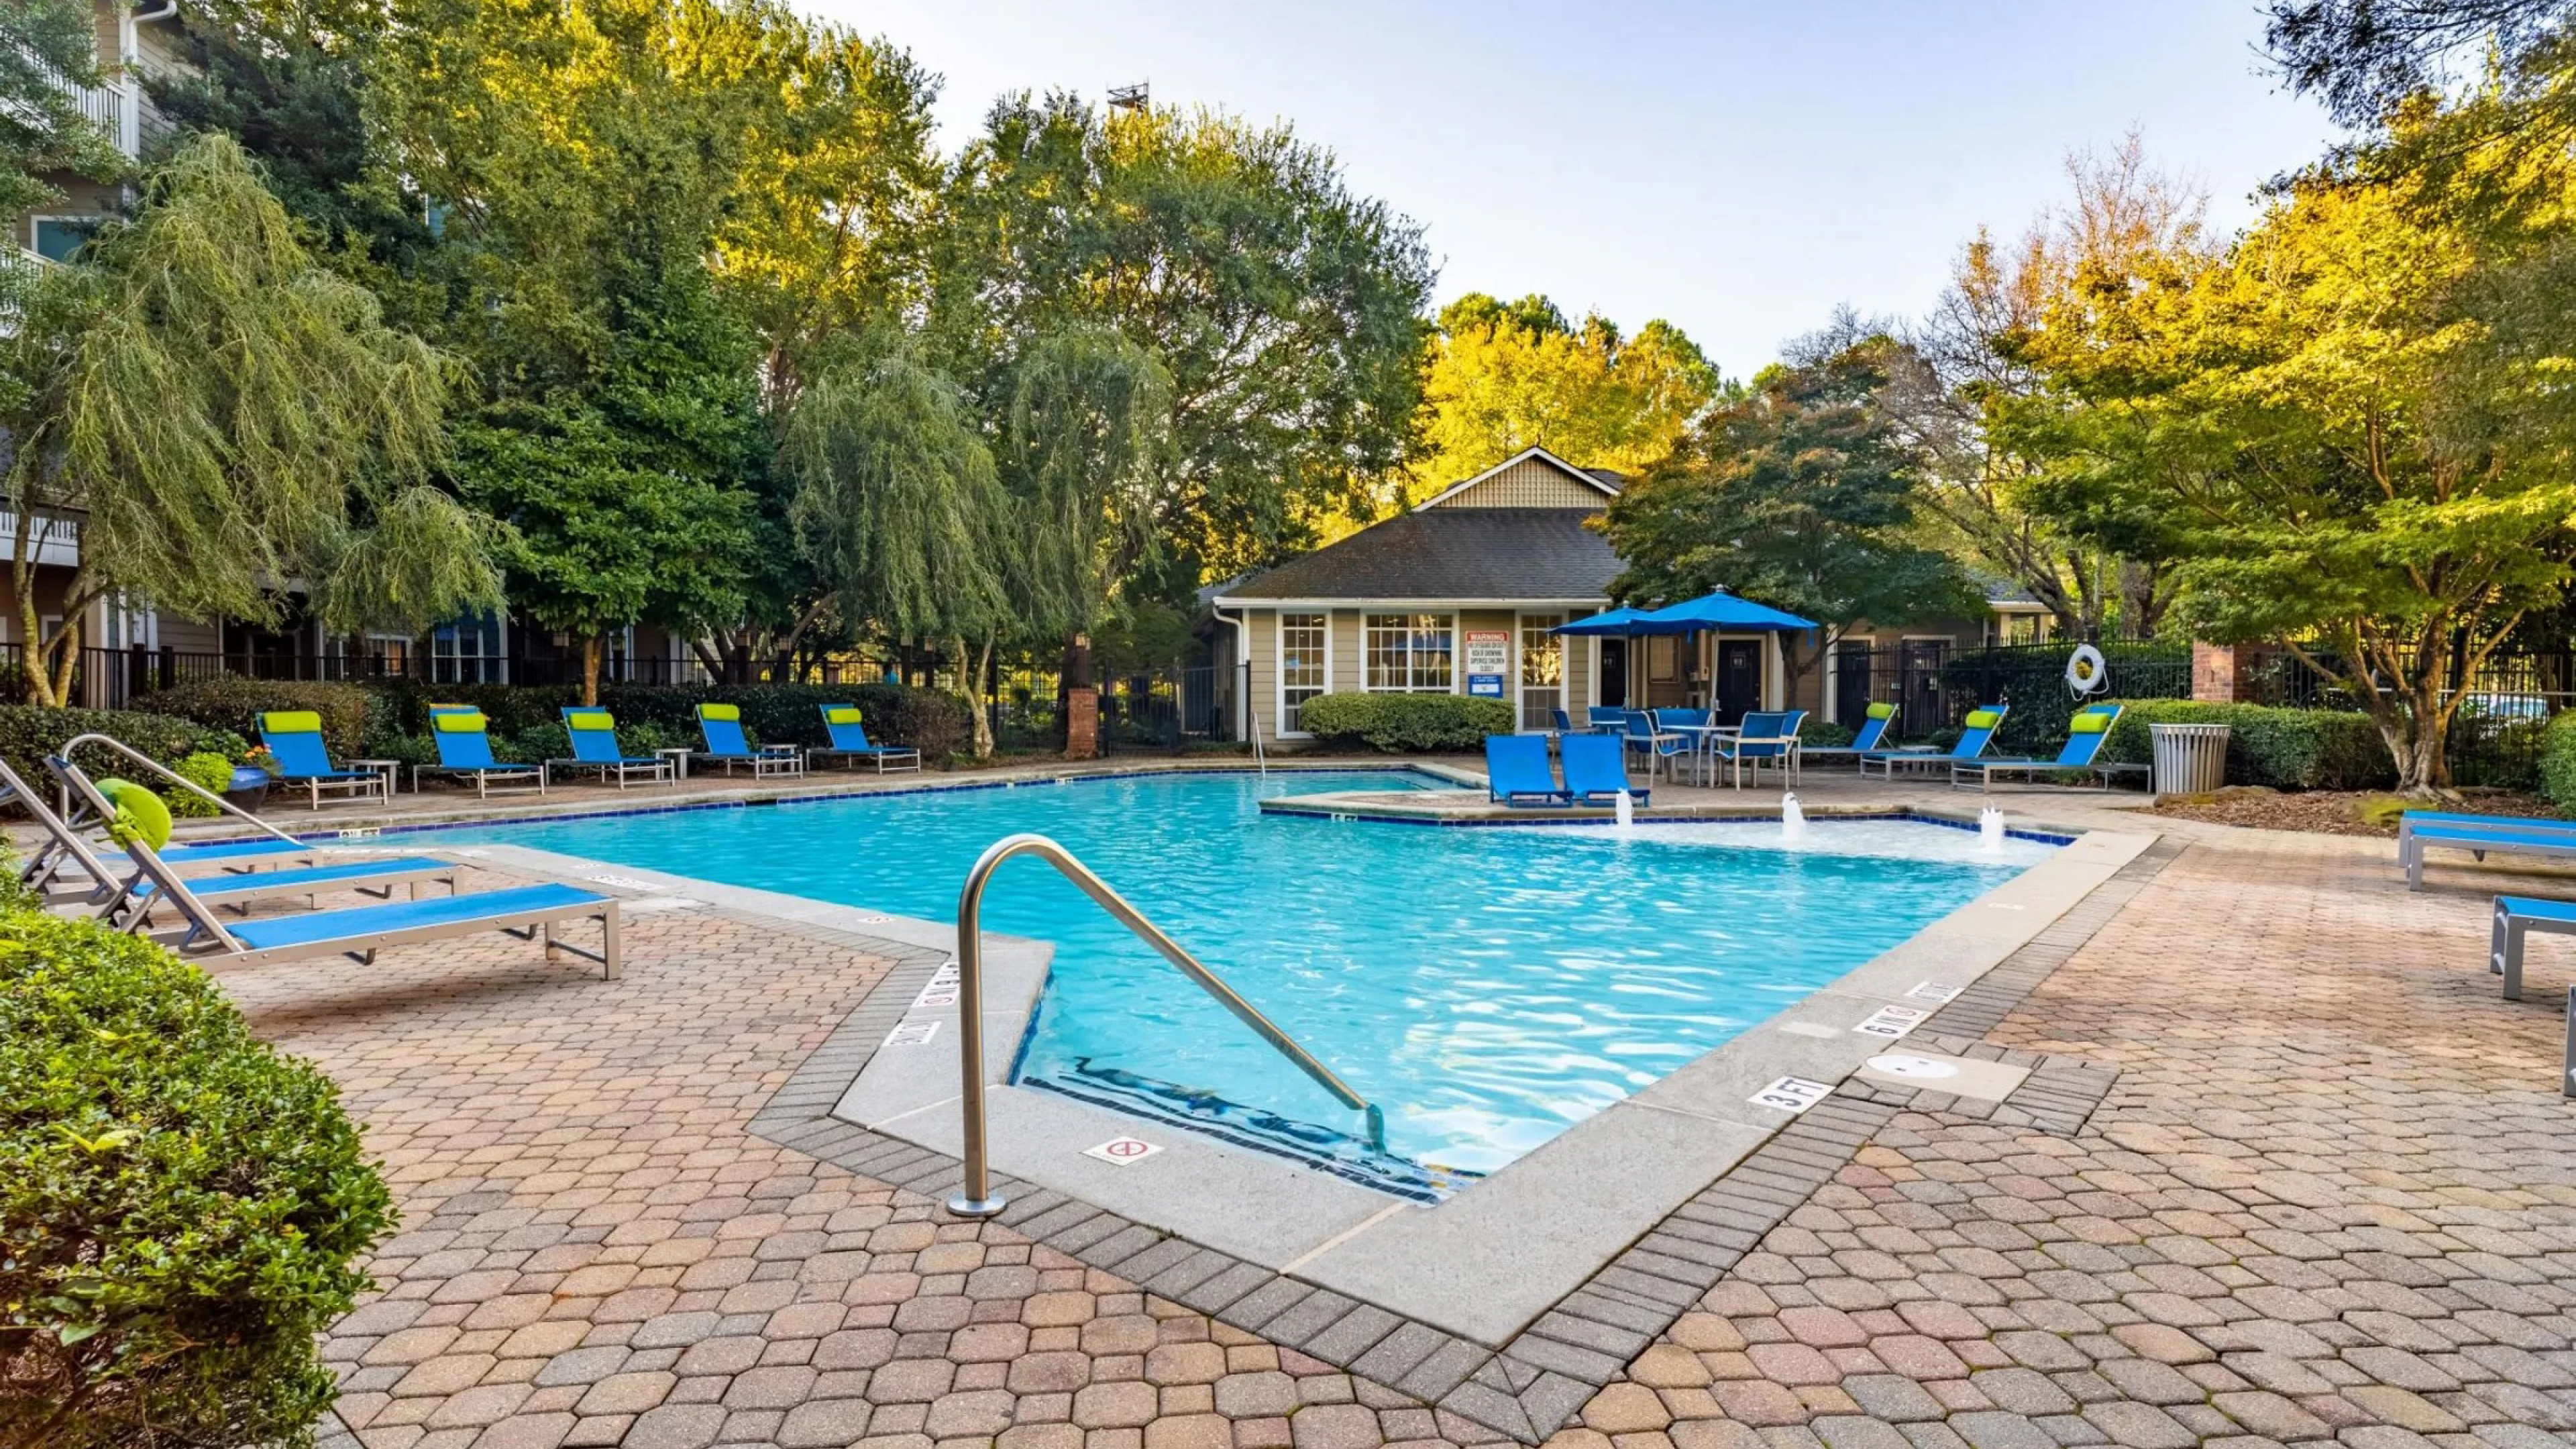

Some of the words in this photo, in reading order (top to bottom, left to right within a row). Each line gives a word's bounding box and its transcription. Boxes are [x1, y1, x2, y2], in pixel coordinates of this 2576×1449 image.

[1874, 1016, 1913, 1028] IN
[1864, 1026, 1898, 1034] 6
[1777, 1079, 1823, 1097] FT
[1762, 1095, 1802, 1107] 3
